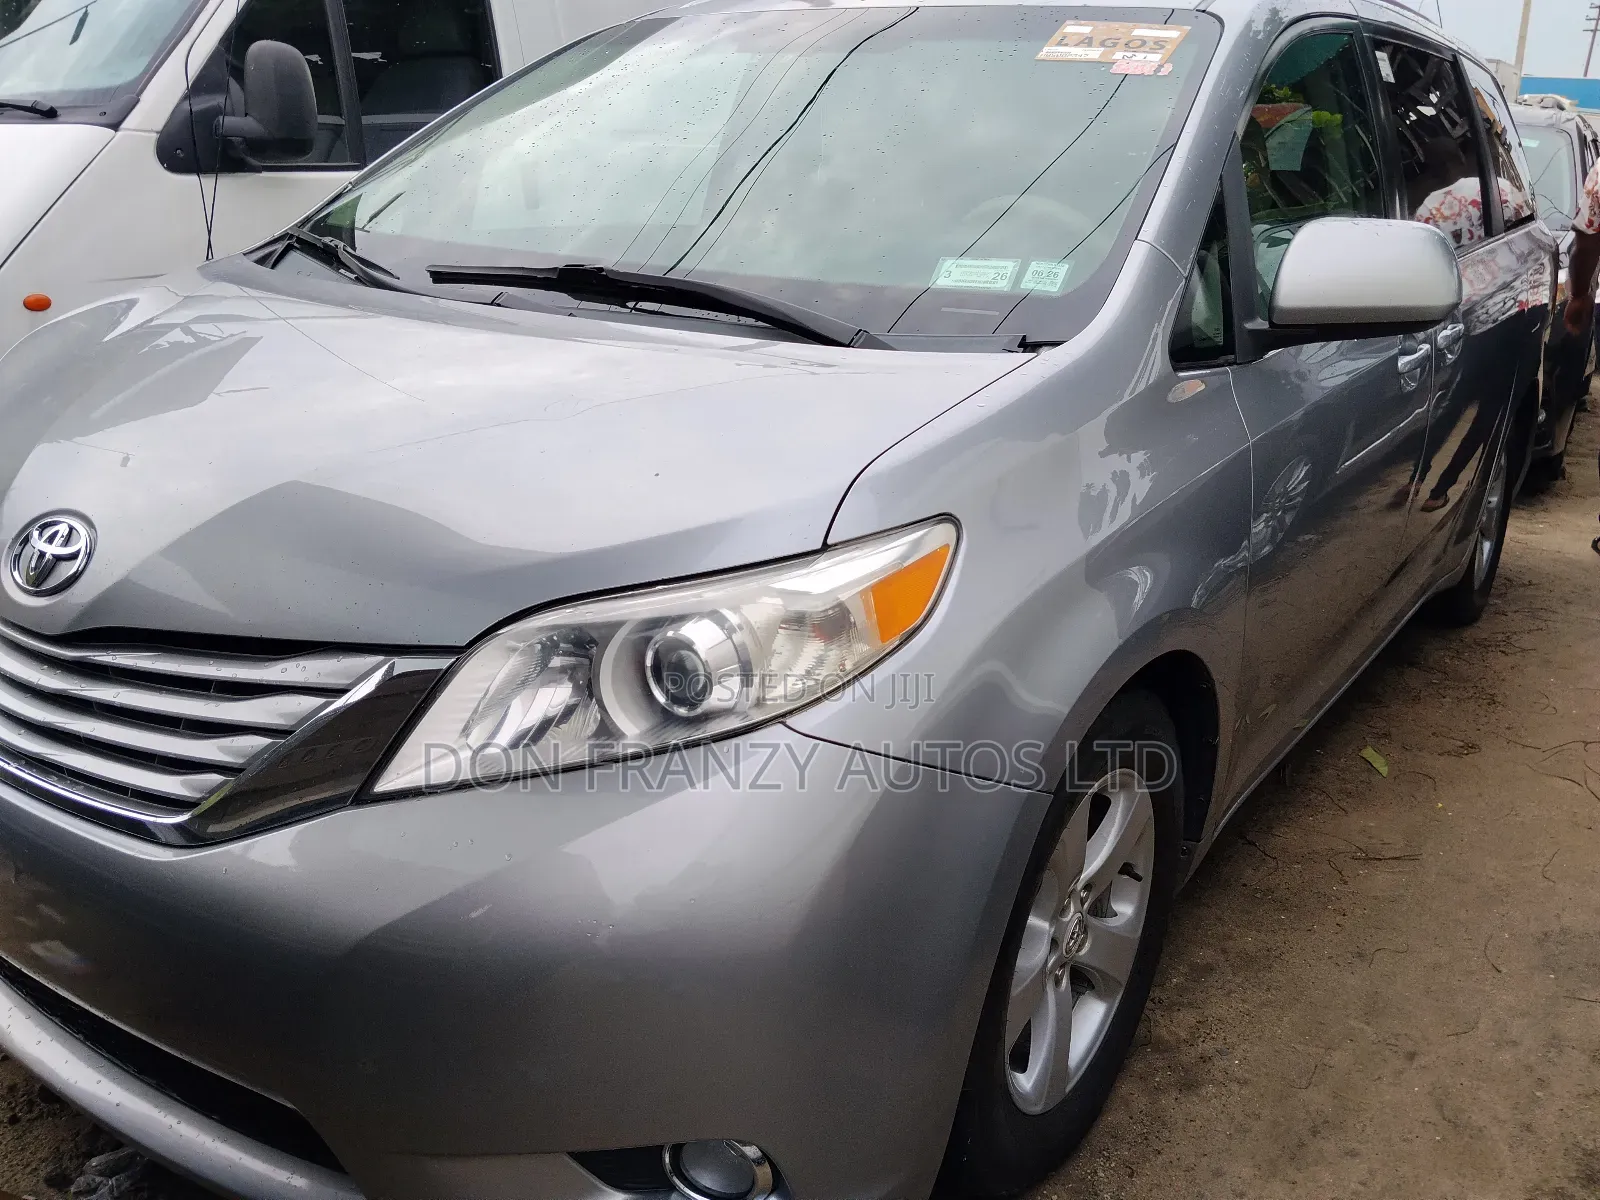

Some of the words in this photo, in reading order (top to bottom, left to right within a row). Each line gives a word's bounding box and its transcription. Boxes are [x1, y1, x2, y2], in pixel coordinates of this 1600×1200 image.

[1055, 36, 1169, 51] LAGOS
[943, 270, 952, 279] 3
[991, 272, 1008, 281] 26
[1031, 269, 1044, 277] 06
[1046, 270, 1060, 279] 26
